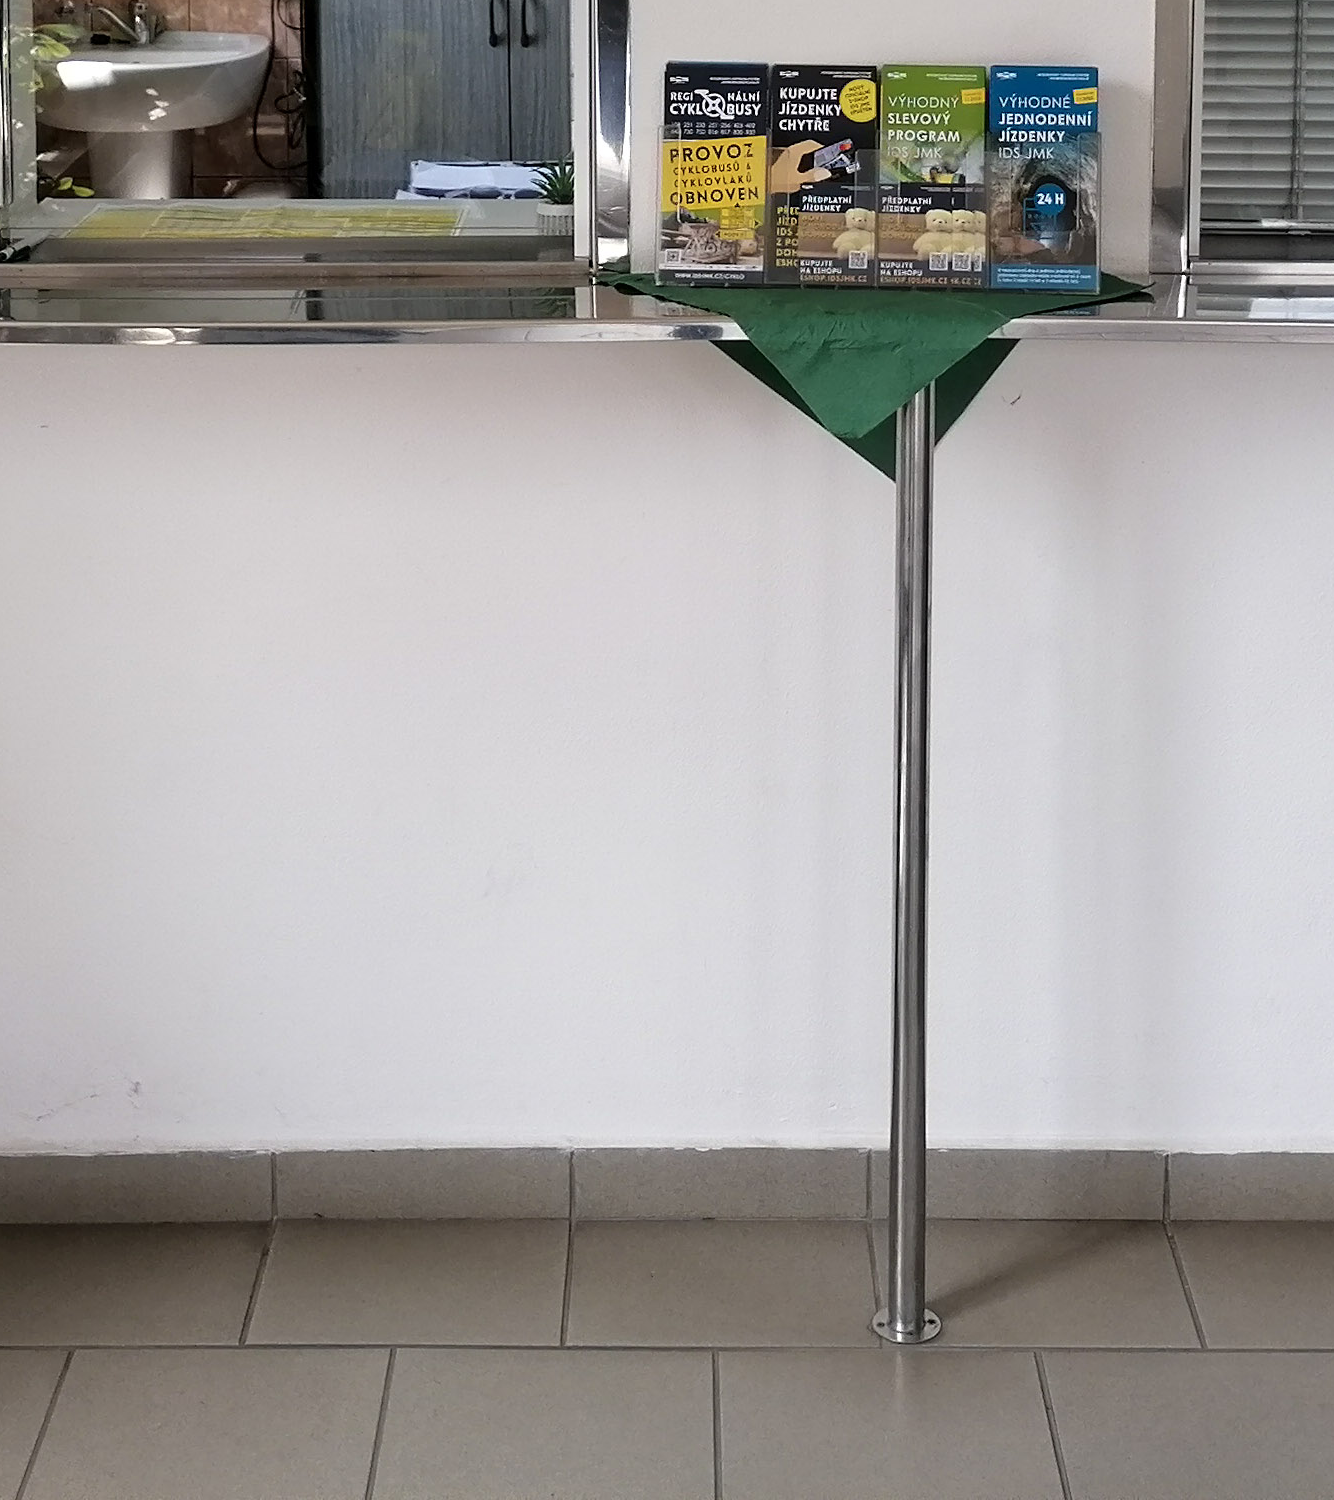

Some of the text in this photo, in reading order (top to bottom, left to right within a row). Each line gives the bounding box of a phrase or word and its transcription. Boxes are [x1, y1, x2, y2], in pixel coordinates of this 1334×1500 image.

[779, 87, 838, 100] KUPUJTE
[888, 93, 959, 108] VÝHODNÝ
[999, 93, 1071, 109] VÝHODNÉ
[778, 101, 841, 116] JÍZDENKY
[778, 117, 830, 131] CHYTŘE
[888, 111, 951, 125] SLEVOVÝ
[998, 111, 1093, 127] JEDNODENNÍ
[888, 130, 961, 142] PROGRAM
[998, 127, 1065, 142] JÍZDENKY
[670, 143, 753, 163] PROVOZ
[887, 146, 942, 158] IDS JMK
[999, 147, 1054, 159] IDS JMK
[673, 162, 740, 176] CYKLOBUSŮ
[670, 187, 759, 206] OBNOVEN
[802, 194, 852, 204] PŘEDPLATNÍ
[881, 195, 932, 205] PŘEDPLATNÍ
[1037, 193, 1064, 205] 24 H
[801, 203, 842, 212] JÍZDENKY
